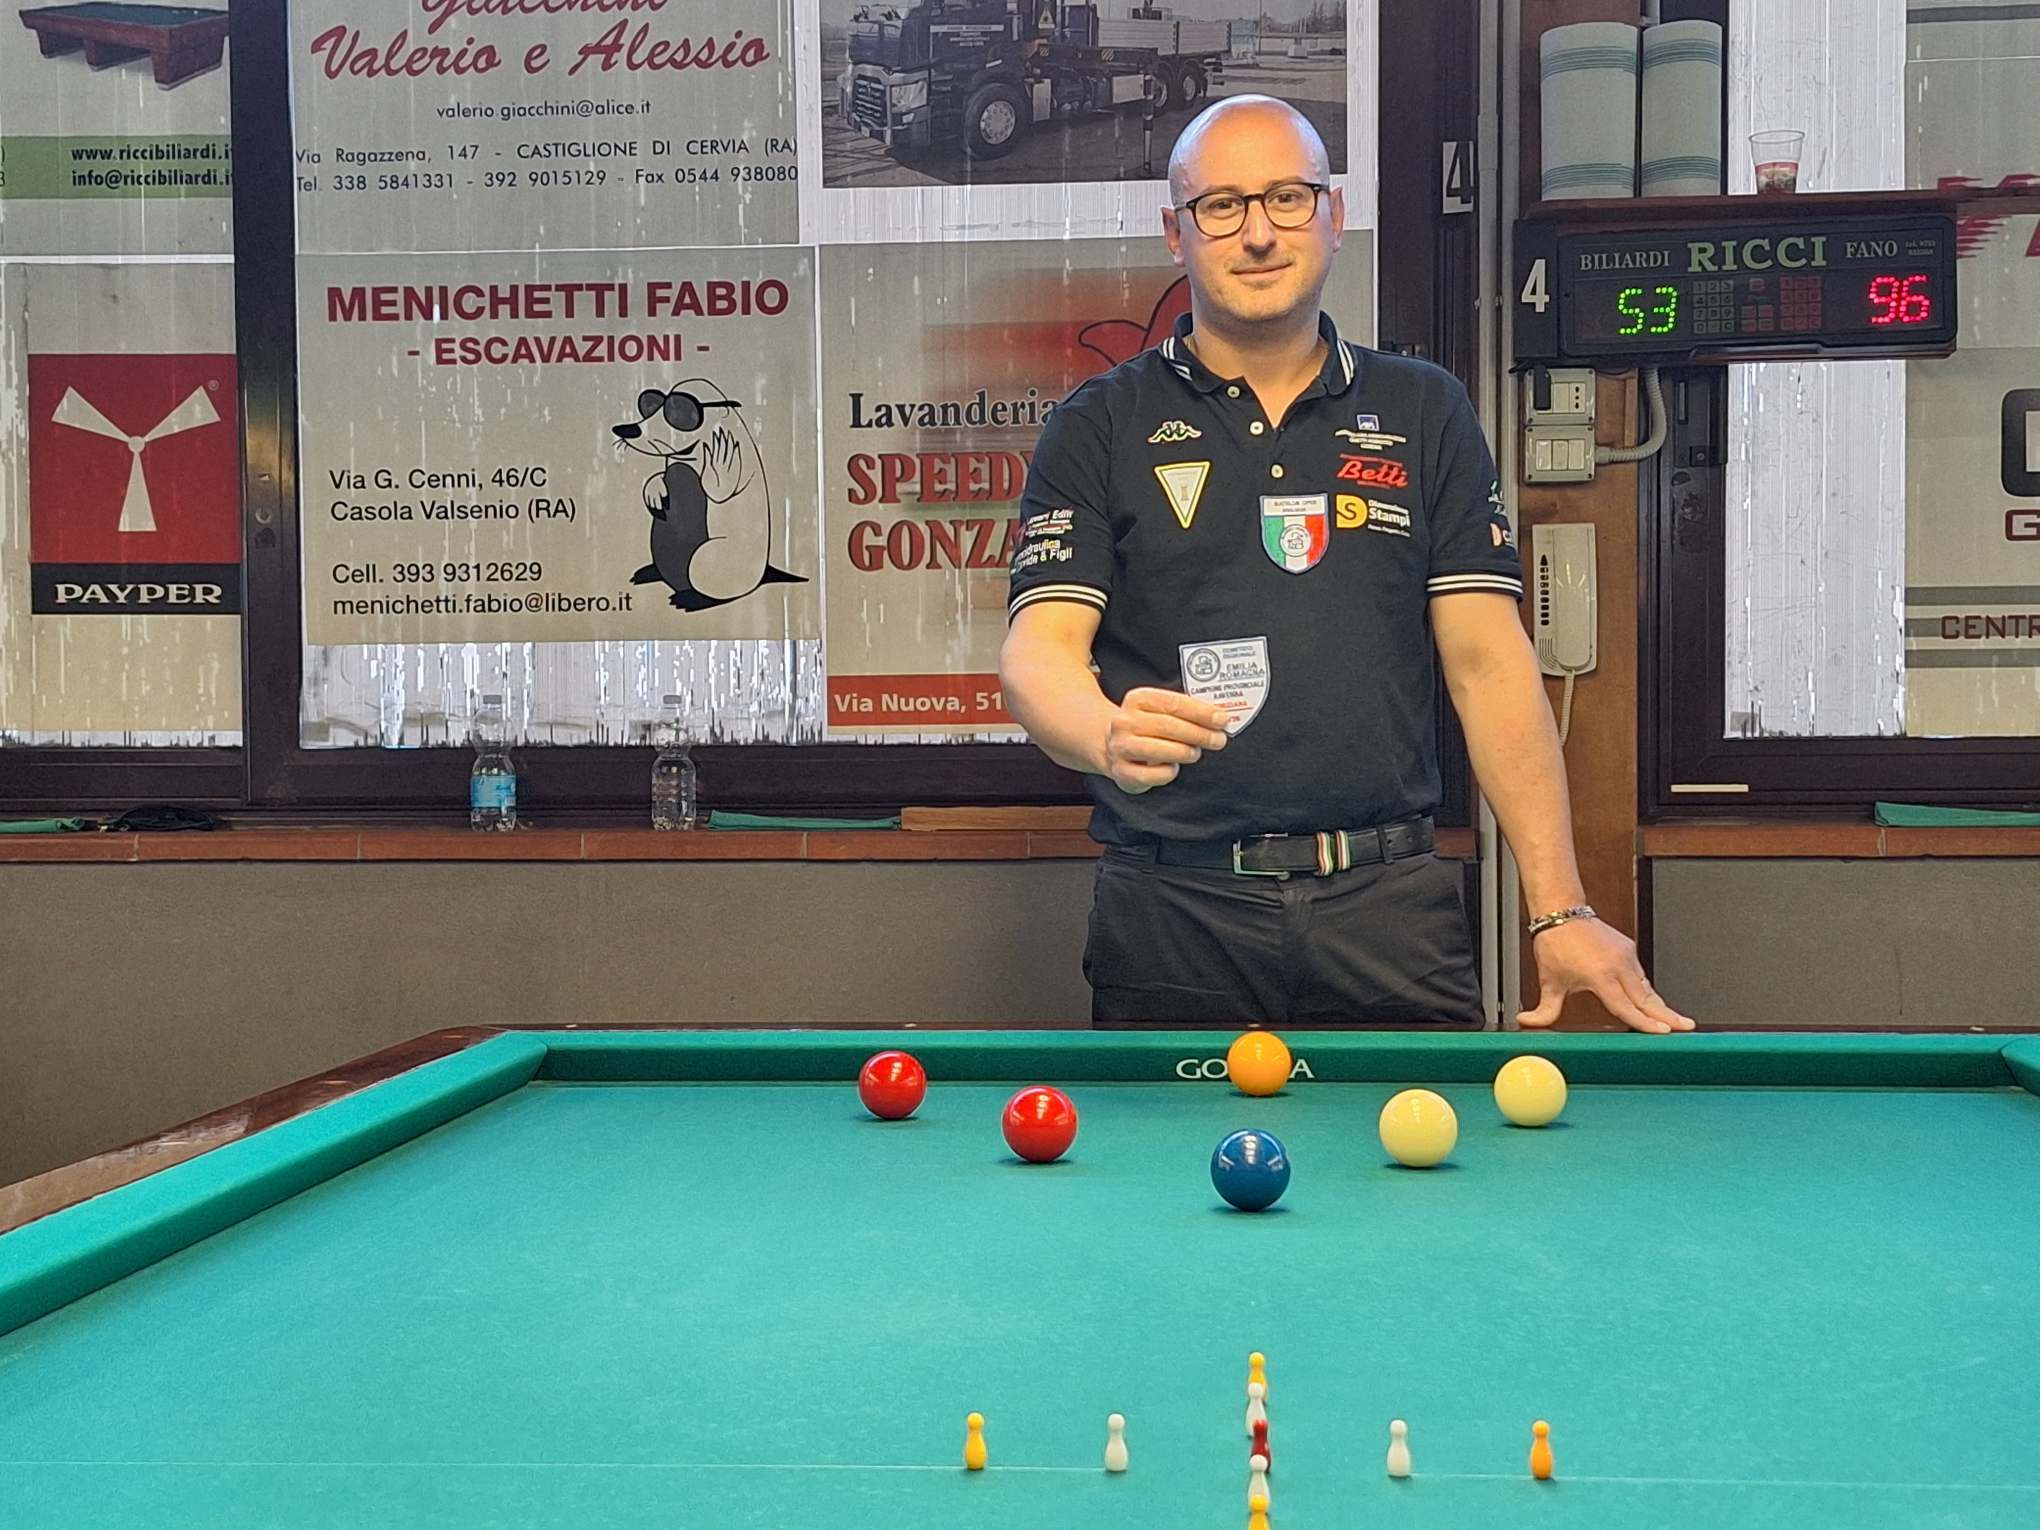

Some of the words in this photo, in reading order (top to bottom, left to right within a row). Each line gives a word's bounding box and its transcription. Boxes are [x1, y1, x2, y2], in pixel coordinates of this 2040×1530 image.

[310, 25, 502, 79] Valerio
[523, 43, 551, 74] e
[568, 18, 770, 76] Alessio
[437, 100, 651, 121] valerio.giacchini@alice.it
[71, 143, 232, 161] www.riccibiliardi.i
[295, 149, 321, 164] Via
[336, 148, 432, 166] Ragazzena,
[447, 144, 480, 160] 147
[516, 141, 638, 159] CASTIGLIONE
[652, 140, 671, 156] DI
[686, 138, 750, 156] CERVIA
[764, 137, 798, 157] (RA)
[71, 168, 232, 190] info@riccibiliardi.i
[333, 175, 368, 190] 338
[377, 172, 454, 190] 5841331
[484, 171, 517, 187] 392
[528, 169, 607, 187] 9015129
[635, 168, 665, 184] Fax
[674, 167, 721, 183] 0544
[730, 165, 798, 182] 938080
[1445, 141, 1474, 205] 4
[1579, 250, 1671, 271] BILIARDI
[1687, 236, 1828, 273] RICCI
[1844, 239, 1899, 259] FANO
[1520, 258, 1550, 313] 4
[326, 282, 629, 323] MENICHETTI
[646, 278, 790, 317] FABIO
[1618, 286, 1679, 336] 53
[1868, 274, 1931, 326] 96
[434, 334, 683, 366] ESCAVAZIONI
[849, 388, 1059, 429] Lavanderia
[329, 469, 366, 489] Via
[374, 468, 400, 489] G.
[408, 468, 483, 491] Cenni,
[491, 466, 547, 488] 46/C
[330, 500, 413, 521] Casola
[420, 498, 520, 520] Valsenio
[528, 498, 577, 523] (RA)
[332, 563, 384, 584] Cell.
[392, 562, 435, 583] 393
[443, 561, 543, 583] 9312629
[54, 583, 223, 604] PAYPER
[333, 592, 633, 615] menichetti.fabio@libero.it
[834, 692, 873, 712] Via
[881, 693, 967, 714] Nuova,
[1175, 1058, 1315, 1079] GOA
